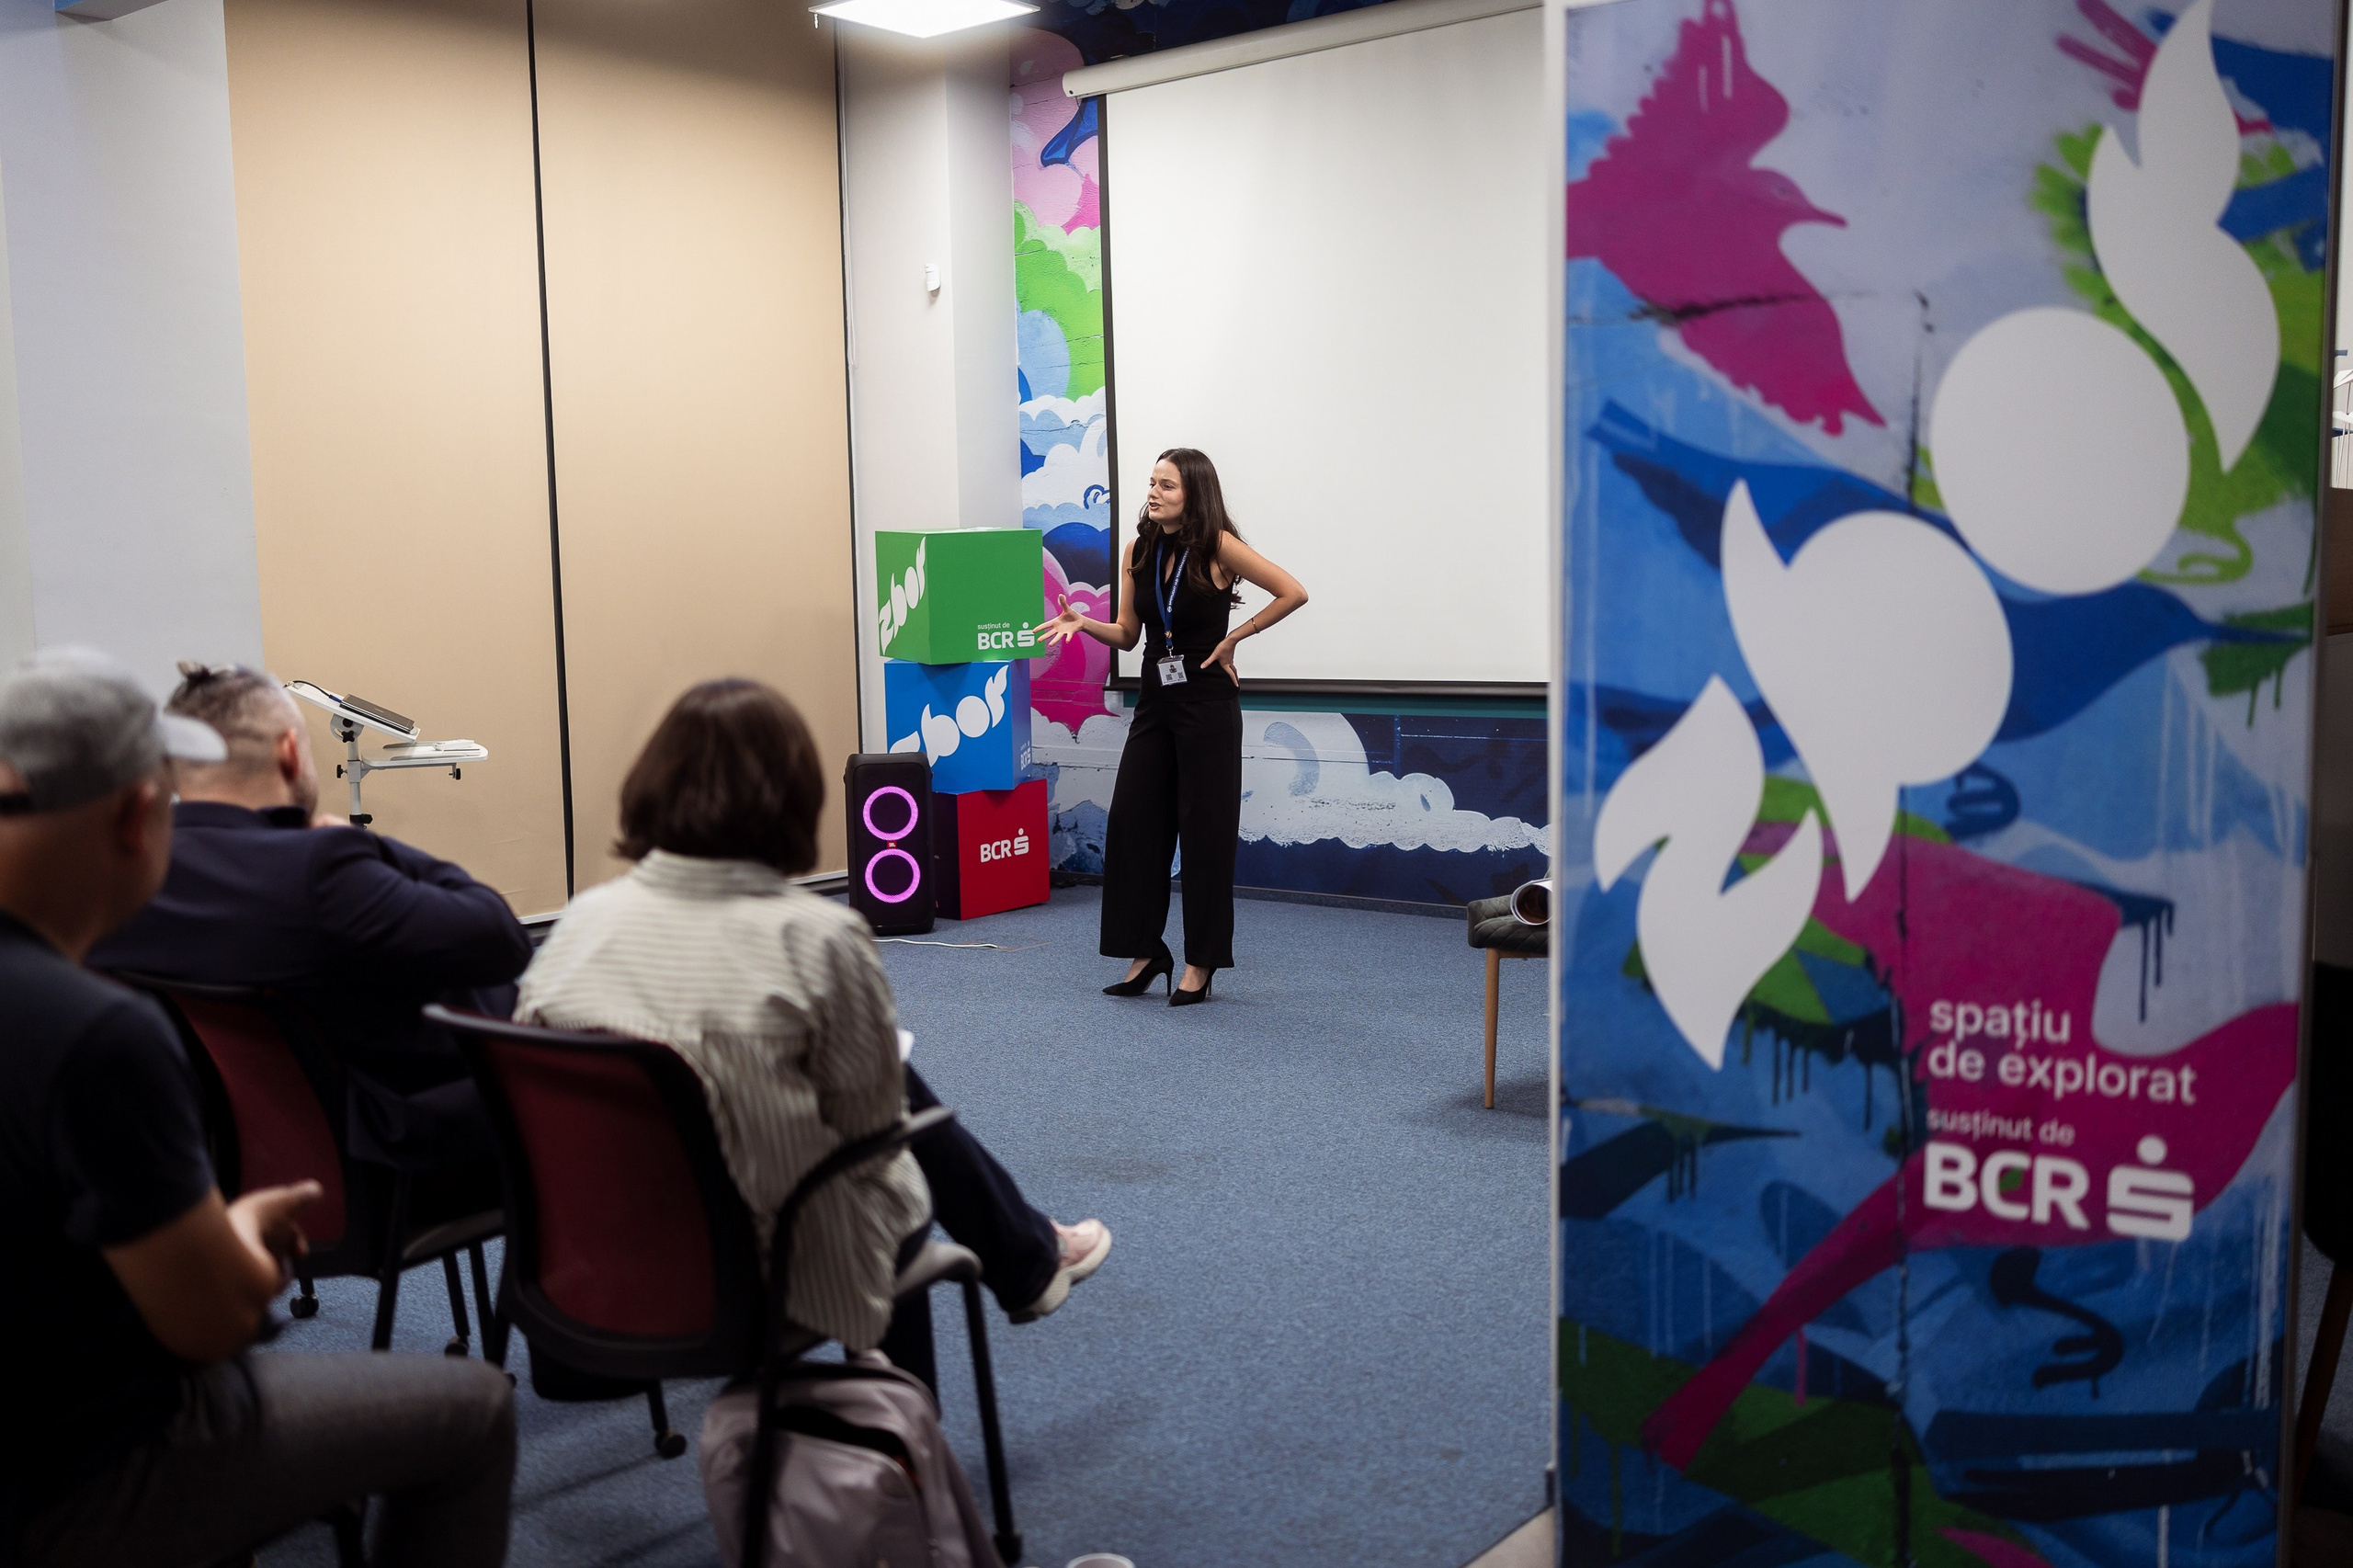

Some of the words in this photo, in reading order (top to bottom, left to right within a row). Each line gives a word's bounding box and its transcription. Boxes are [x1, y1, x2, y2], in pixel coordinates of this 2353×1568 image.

[977, 631, 1015, 650] BCR
[980, 839, 1012, 863] BCR
[1928, 998, 2072, 1051] spațiu
[1927, 1040, 1986, 1083] de
[1997, 1051, 2198, 1107] explorat
[2038, 1117, 2076, 1147] de
[1923, 1140, 2091, 1231] BCR
